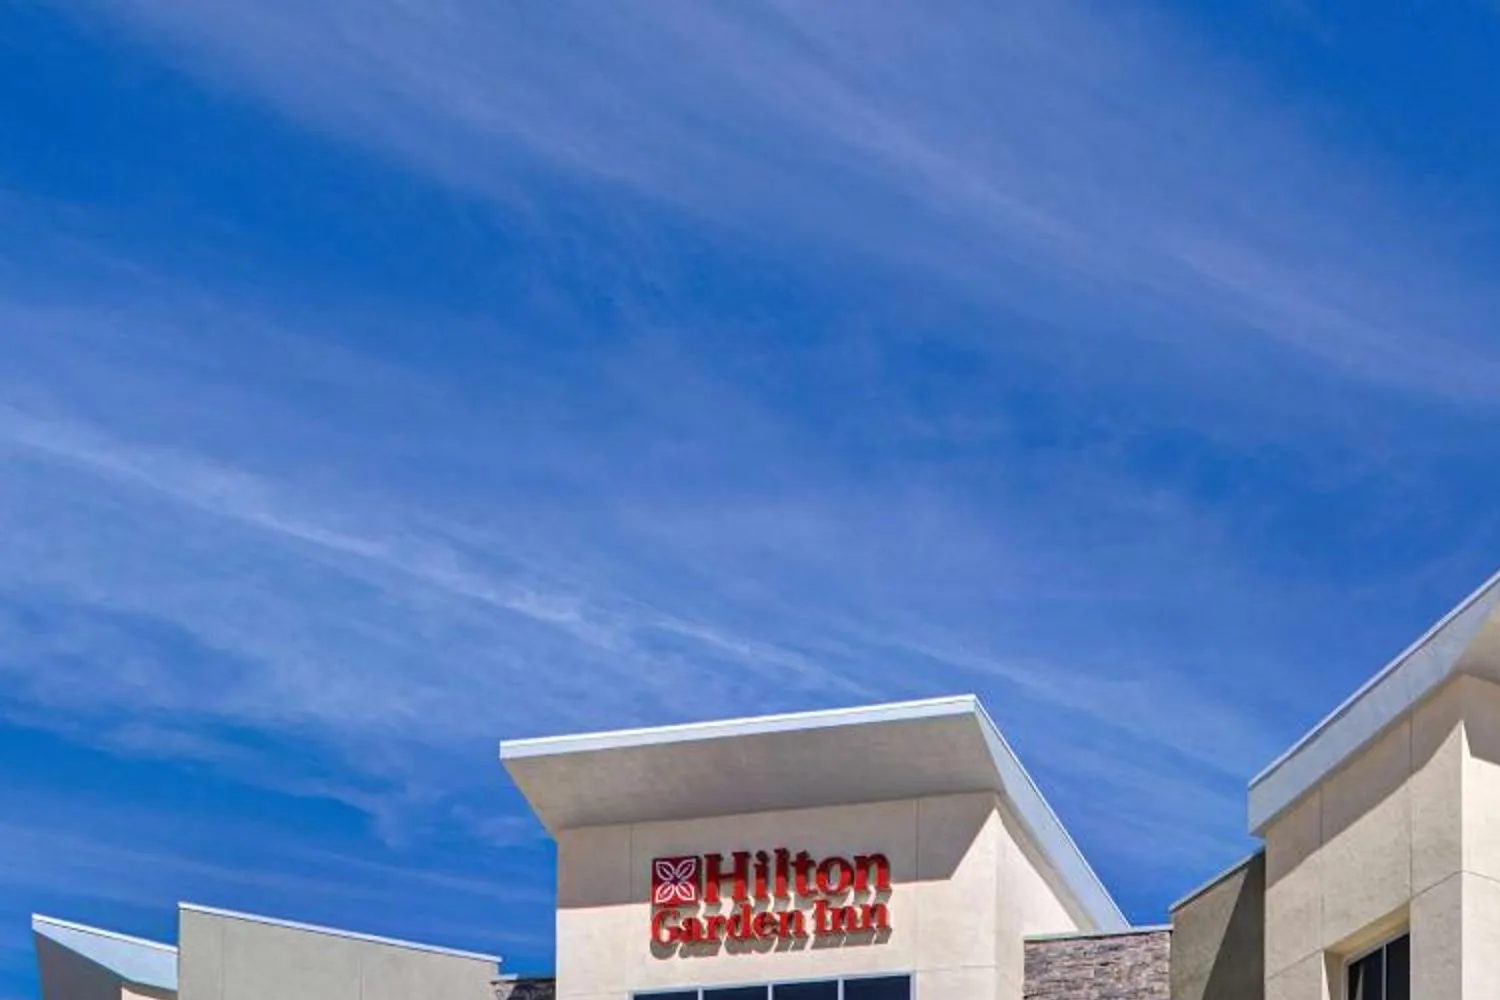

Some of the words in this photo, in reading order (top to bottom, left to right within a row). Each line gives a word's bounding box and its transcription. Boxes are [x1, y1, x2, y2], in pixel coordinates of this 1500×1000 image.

[704, 847, 891, 903] Hilton
[651, 903, 807, 944] Garden
[813, 899, 889, 936] Inn
